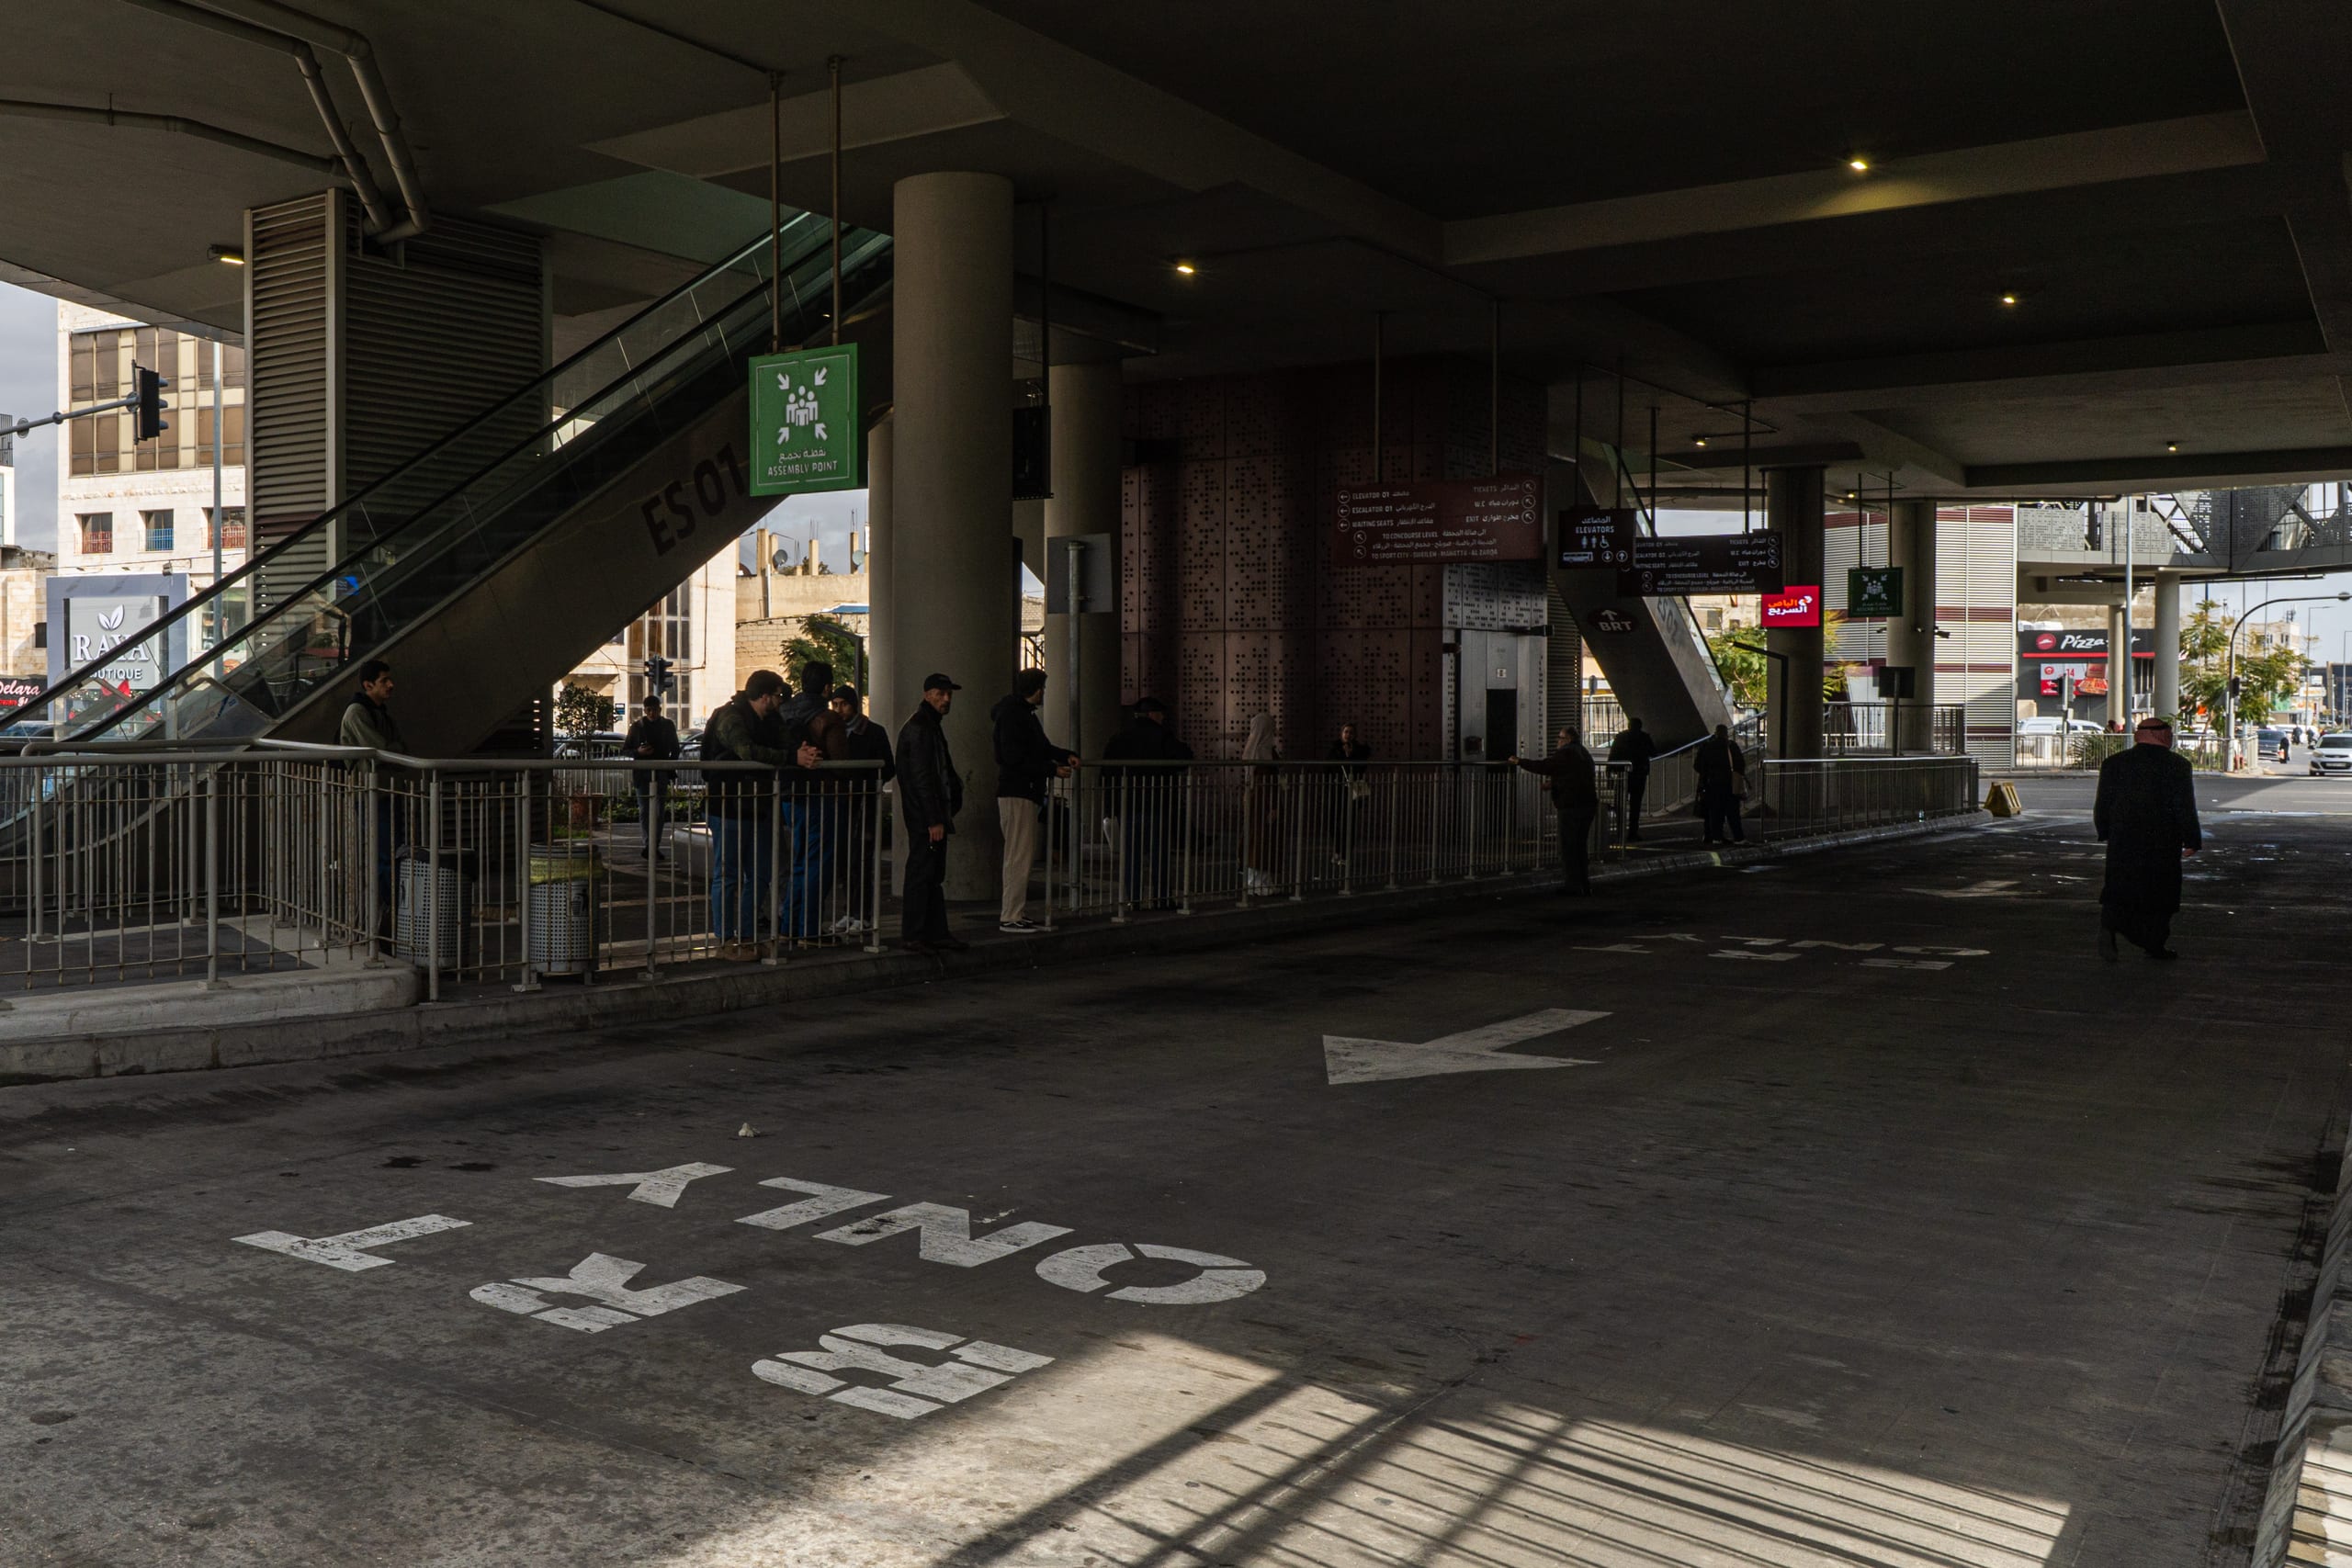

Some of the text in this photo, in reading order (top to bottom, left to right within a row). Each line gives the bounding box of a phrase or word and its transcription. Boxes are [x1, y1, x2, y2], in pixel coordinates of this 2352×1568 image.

[768, 460, 837, 476] ASSEMBLY POINT
[1575, 525, 1615, 534] ELEVATORS
[1768, 599, 1798, 608] الباص
[1768, 606, 1808, 616] السريع
[1599, 621, 1632, 632] BRT
[2060, 634, 2105, 650] Pizza
[532, 1162, 1267, 1304] ONLY
[229, 1213, 1057, 1420] BRT
